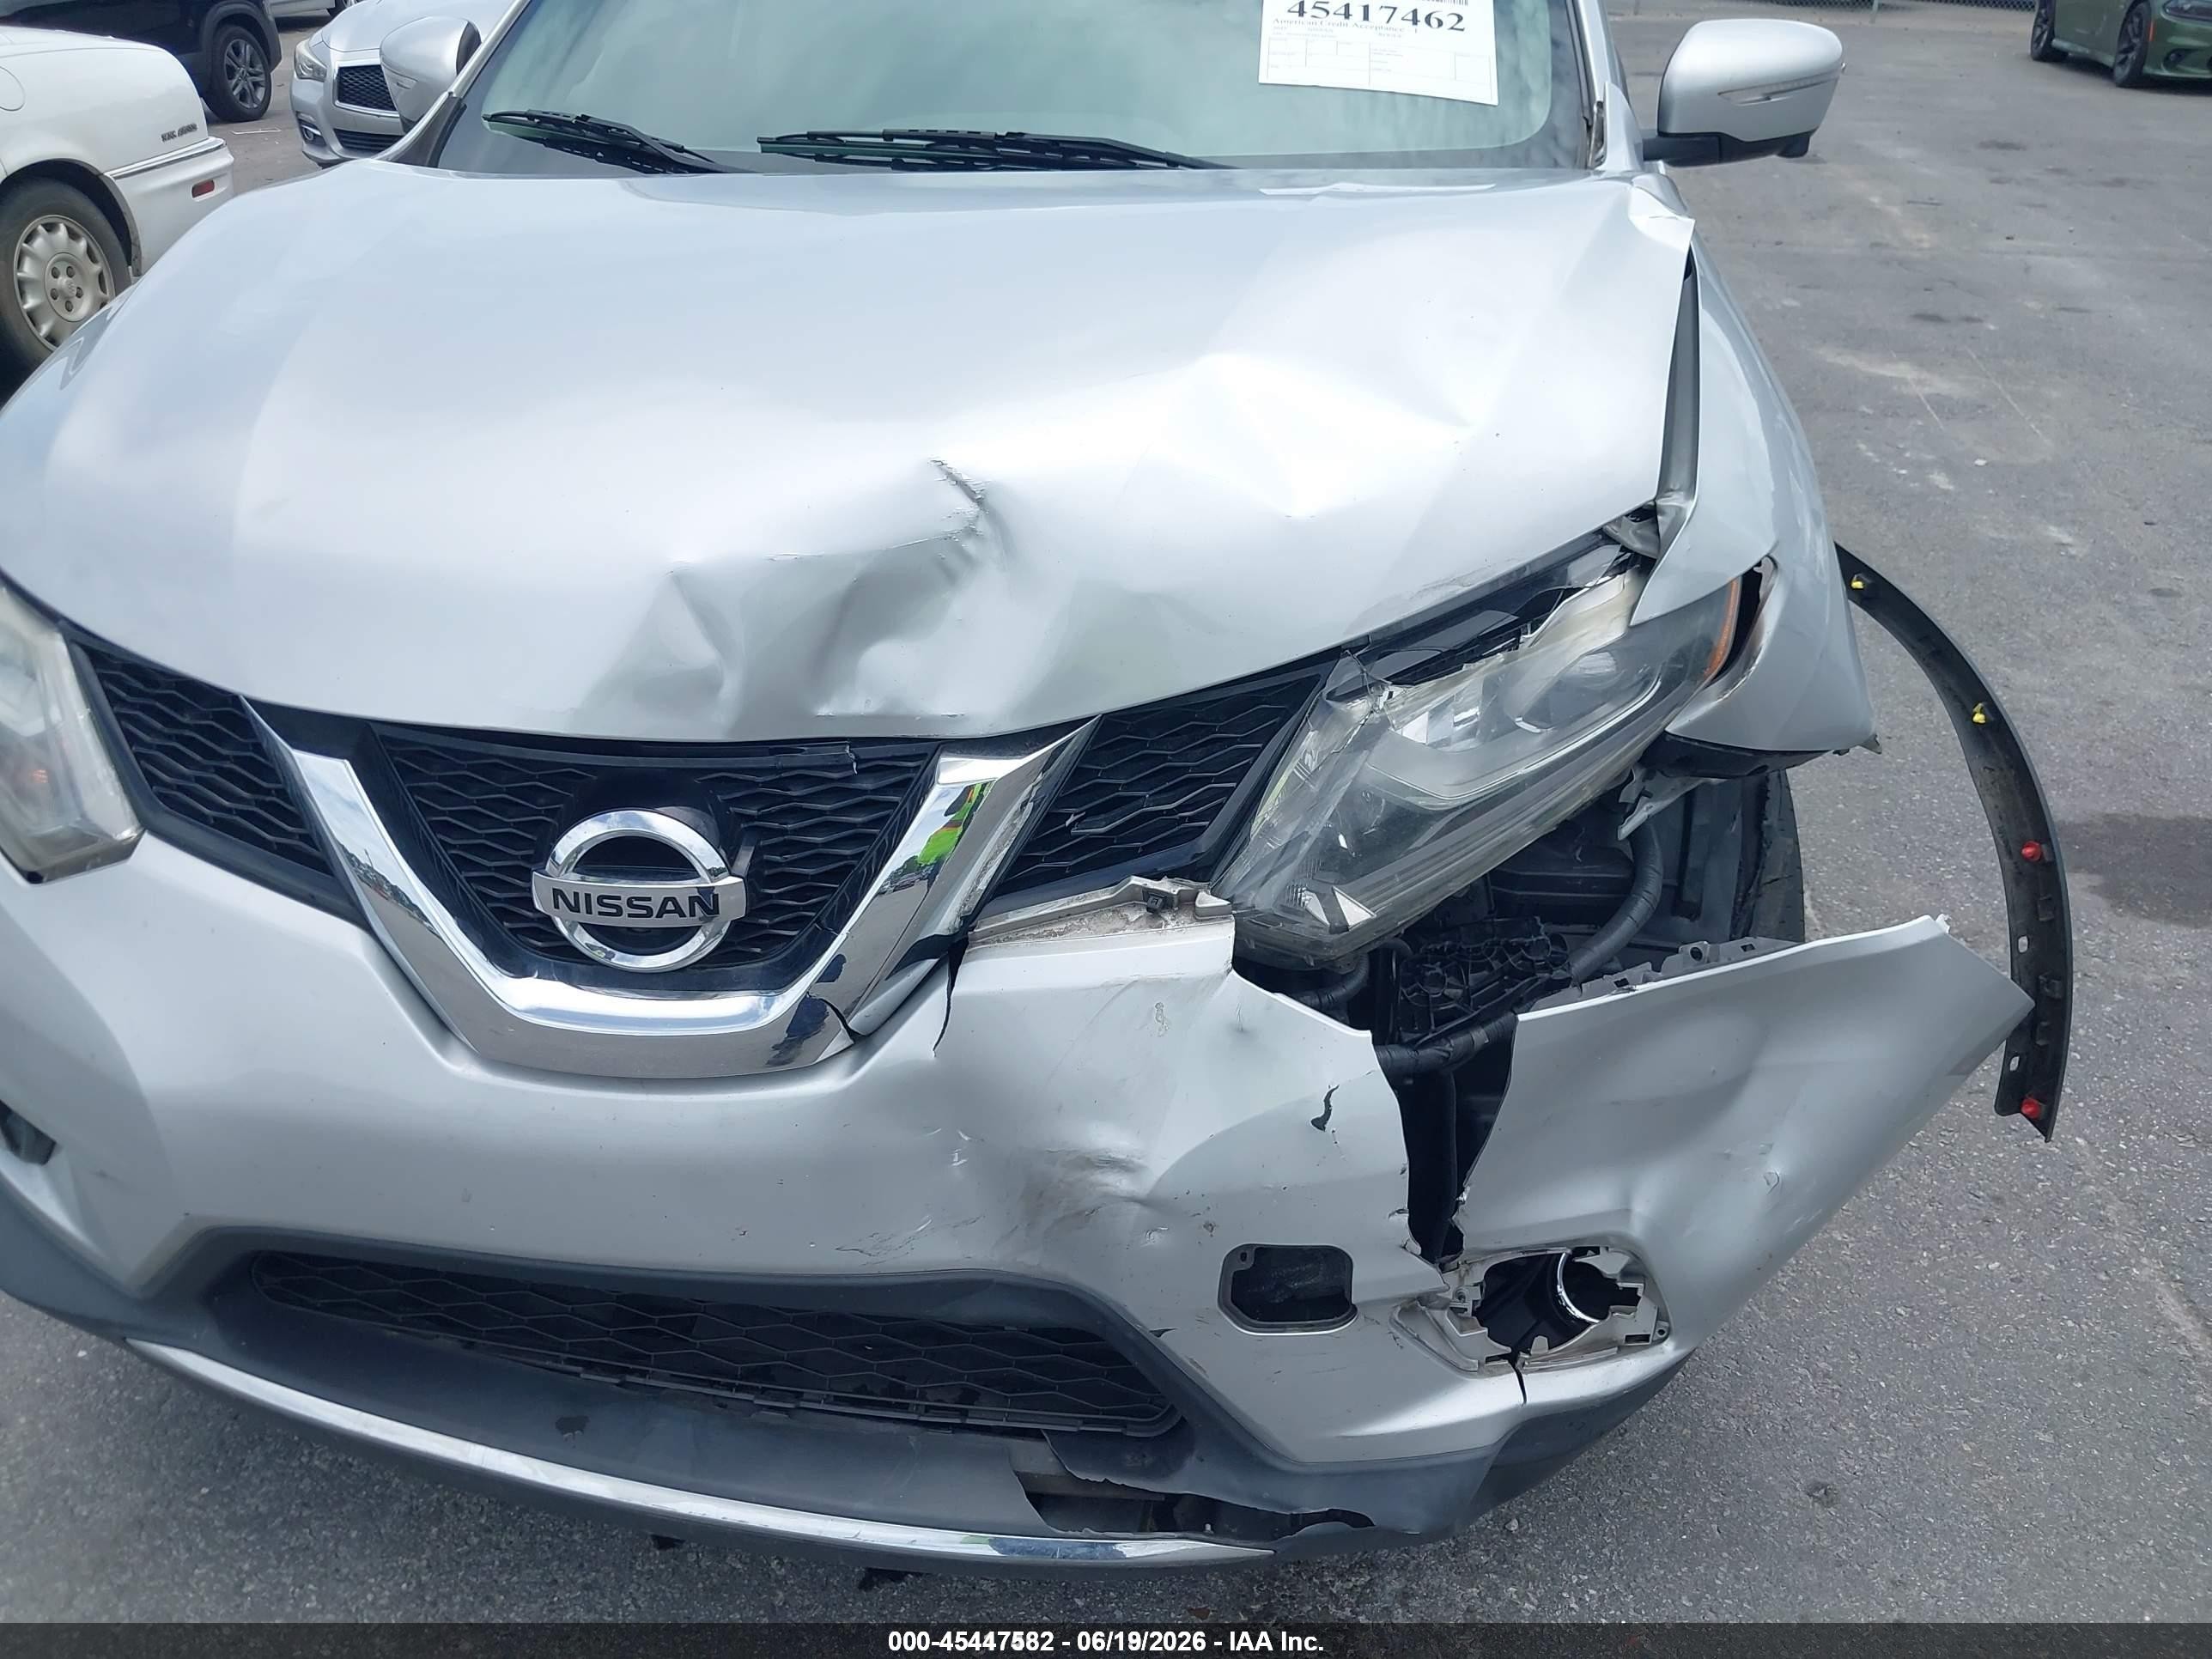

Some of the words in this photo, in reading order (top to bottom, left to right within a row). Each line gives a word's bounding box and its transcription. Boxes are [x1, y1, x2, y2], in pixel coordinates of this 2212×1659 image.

[1273, 18, 1317, 28] American
[1320, 20, 1348, 28] Credit
[1352, 21, 1405, 33] Acceptance
[1287, 0, 1465, 32] 45417462
[552, 888, 720, 918] NISSAN
